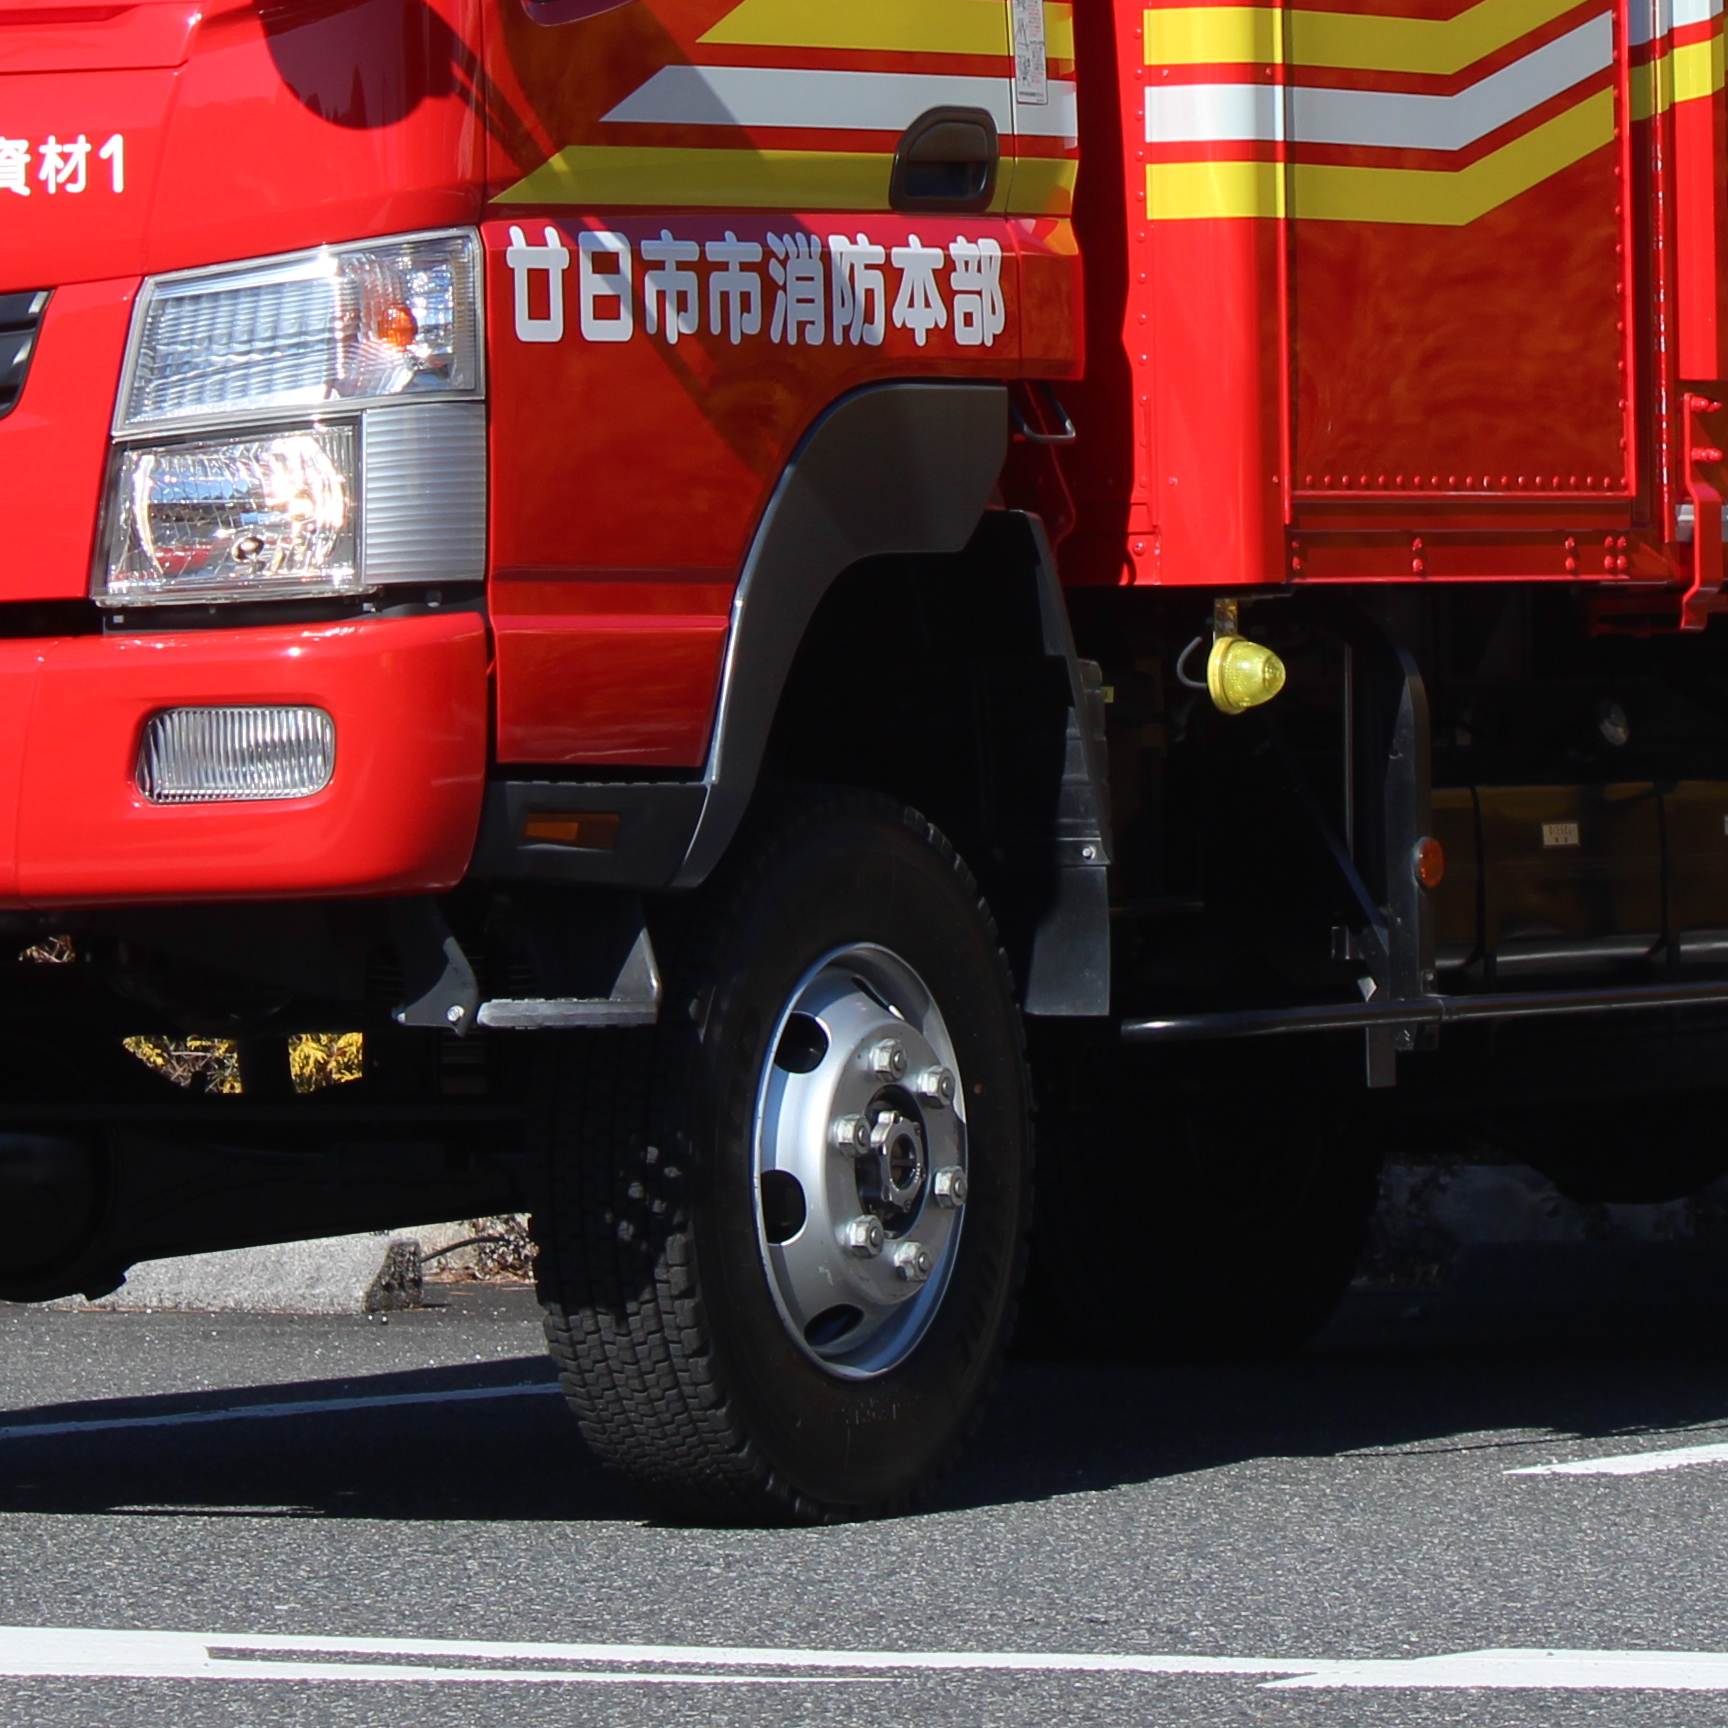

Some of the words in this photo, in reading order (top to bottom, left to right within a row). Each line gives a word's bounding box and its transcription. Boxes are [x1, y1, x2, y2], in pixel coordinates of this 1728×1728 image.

[505, 225, 1006, 347] 廿日市市消防本部
